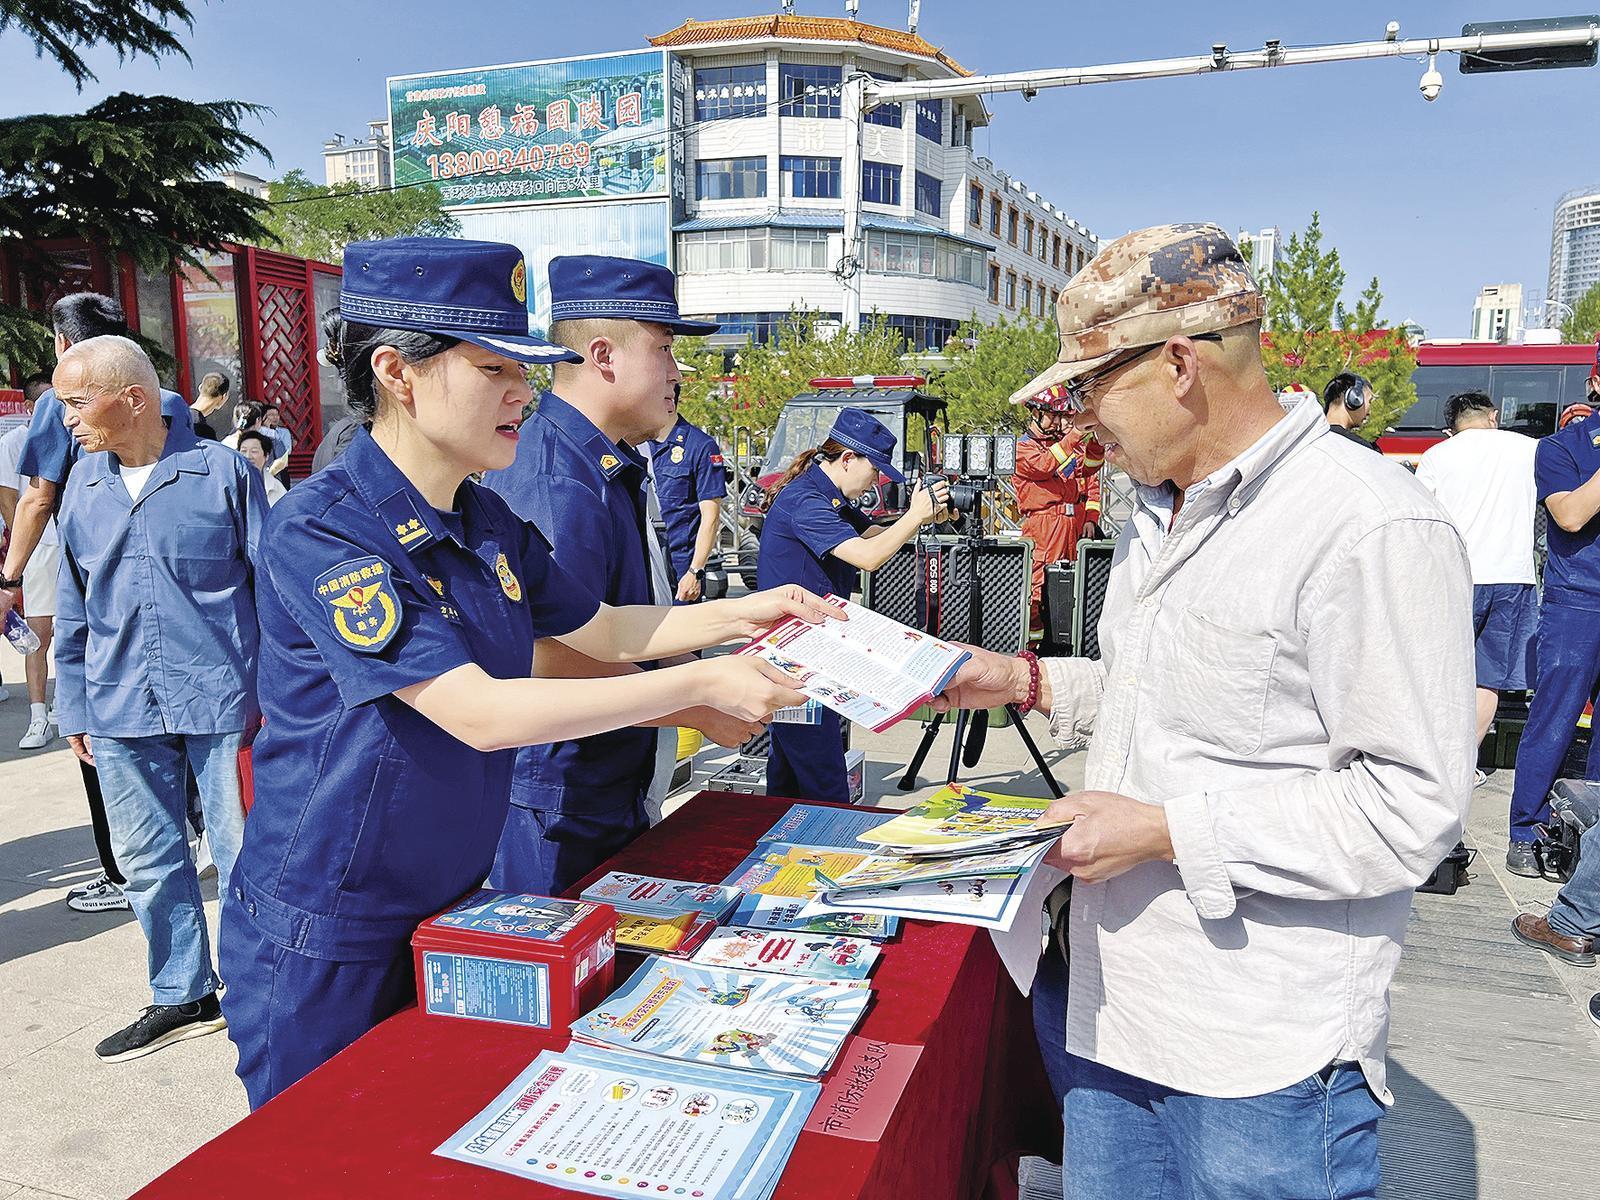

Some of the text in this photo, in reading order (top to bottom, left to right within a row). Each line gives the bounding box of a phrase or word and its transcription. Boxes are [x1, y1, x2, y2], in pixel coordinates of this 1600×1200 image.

[427, 142, 591, 180] 13809340789
[317, 562, 384, 596] 中国消防救援
[929, 557, 938, 578] EOS
